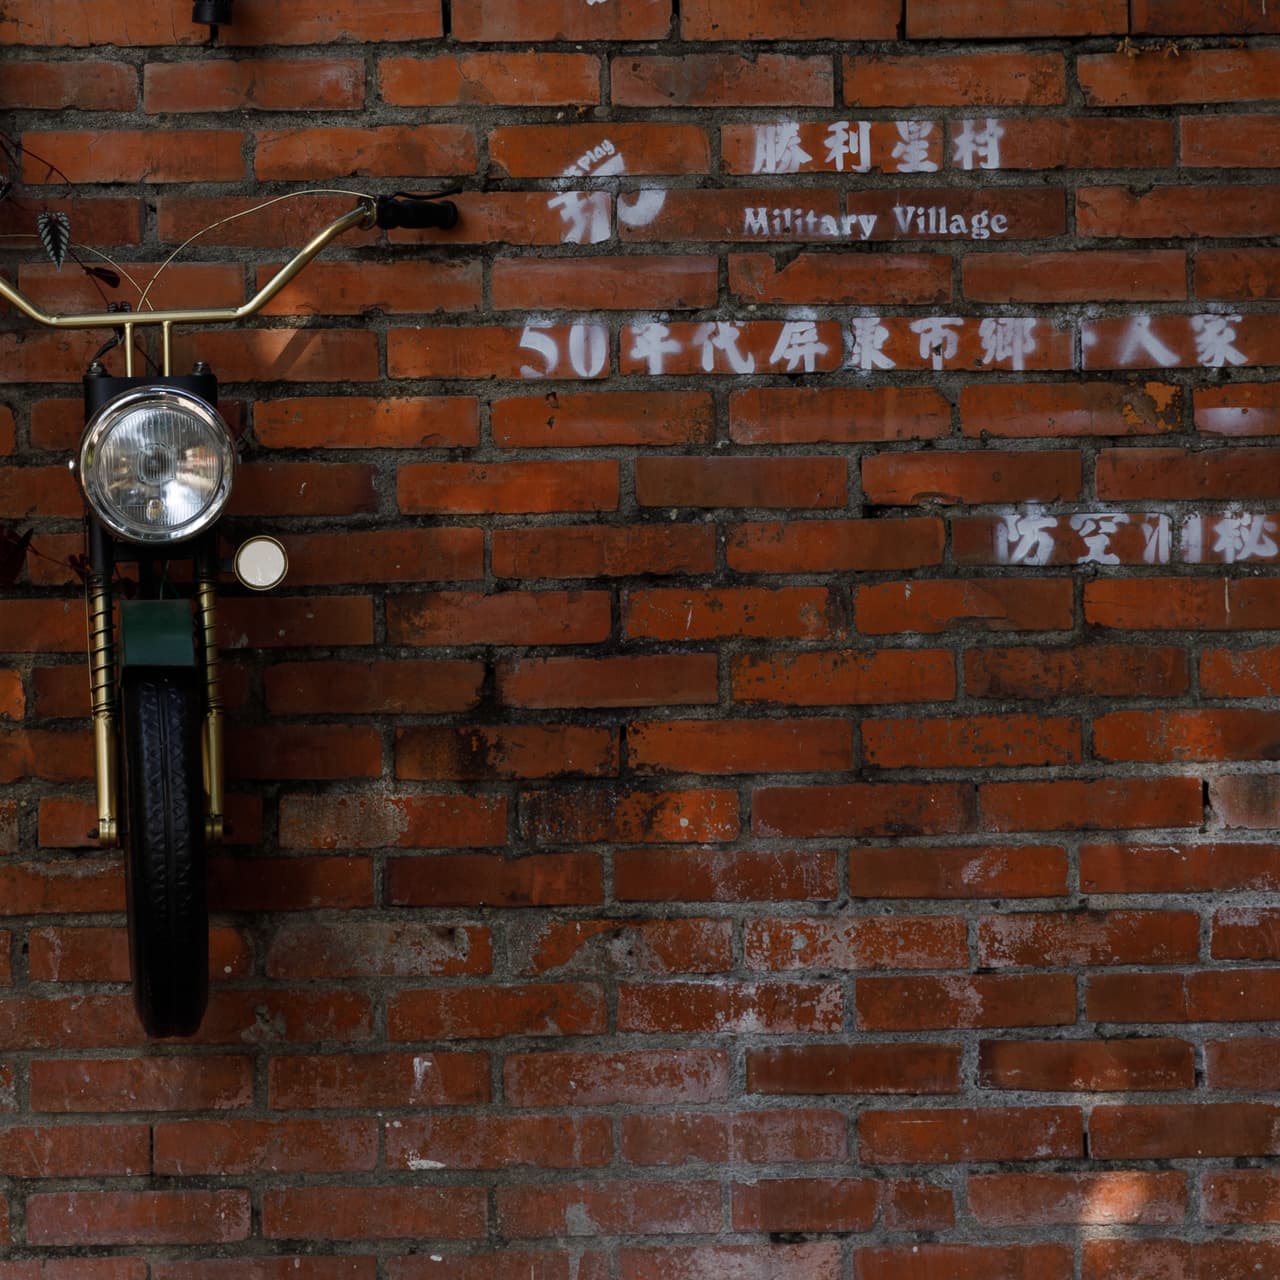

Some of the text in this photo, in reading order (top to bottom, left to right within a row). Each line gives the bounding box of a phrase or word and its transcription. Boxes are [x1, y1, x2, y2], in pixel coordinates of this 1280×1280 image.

[753, 119, 1005, 173] 勝利星村
[744, 205, 1010, 240] Military Village
